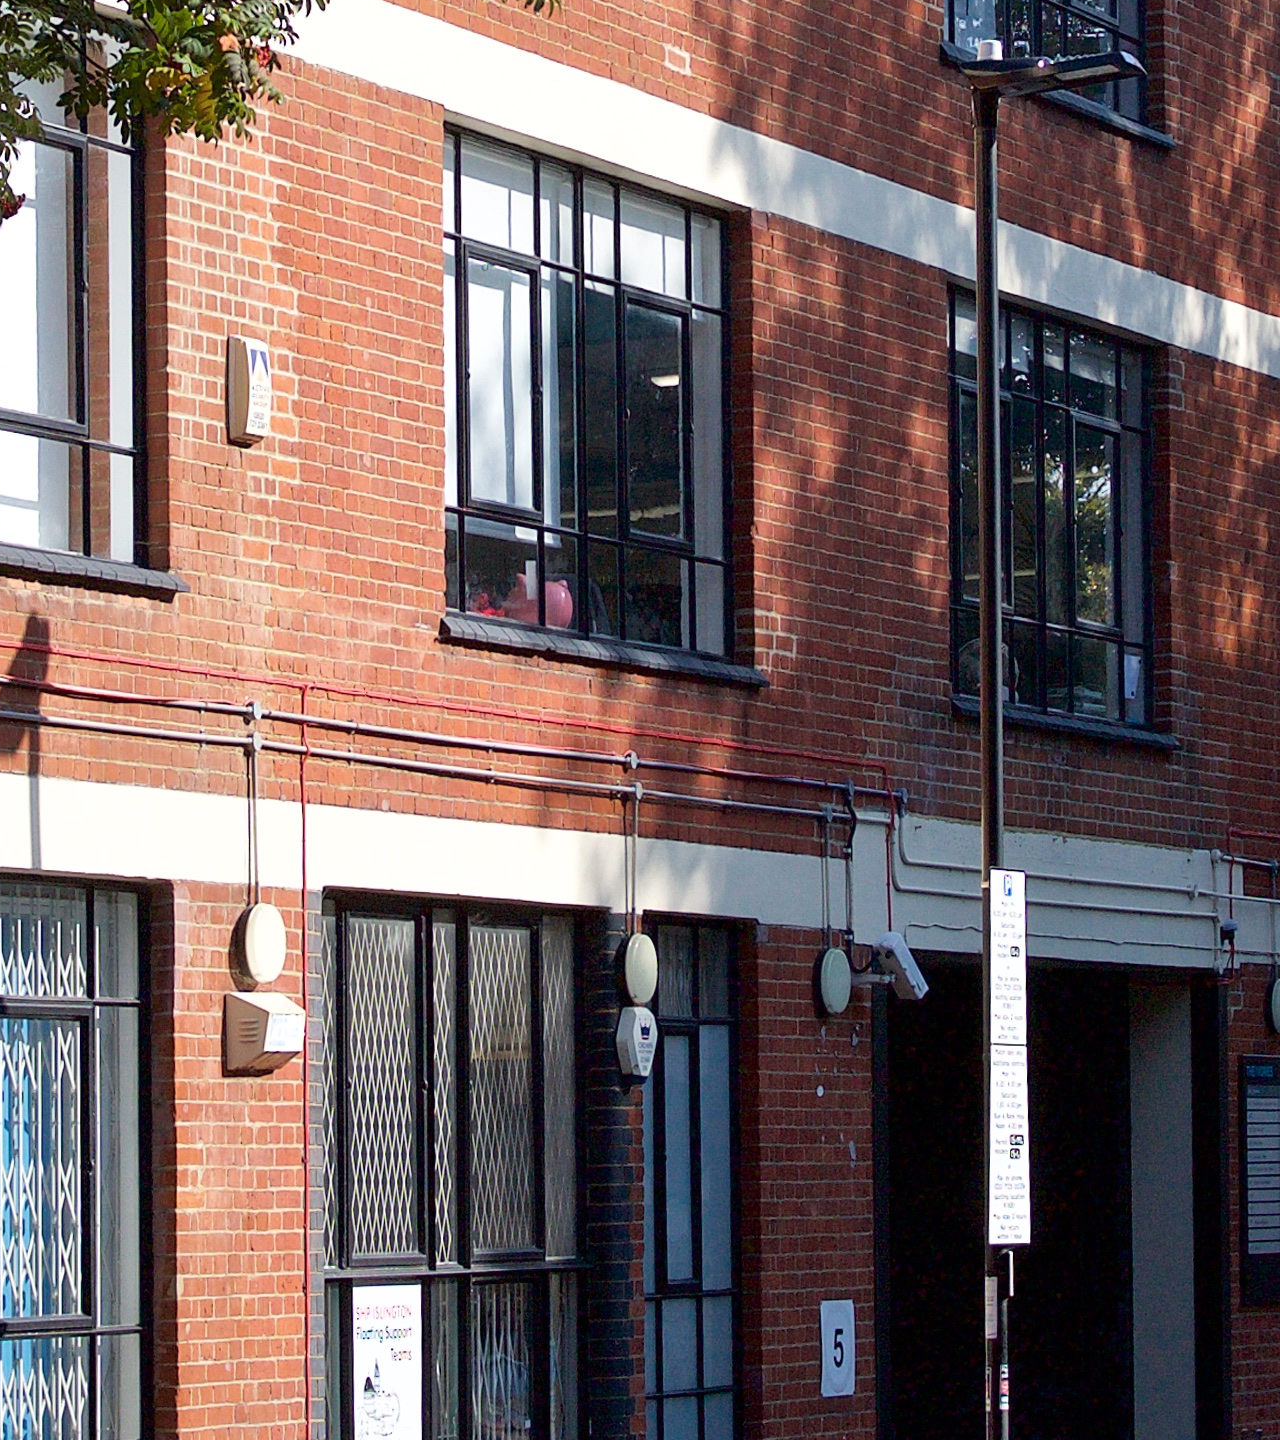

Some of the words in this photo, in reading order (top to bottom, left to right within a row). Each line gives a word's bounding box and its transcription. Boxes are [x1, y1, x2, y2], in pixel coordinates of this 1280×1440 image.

[356, 1307, 370, 1320] SHP
[373, 1305, 412, 1320] ISLINGTON
[356, 1324, 384, 1343] Floating
[385, 1325, 412, 1342] Support
[390, 1347, 412, 1361] Teams
[834, 1329, 844, 1368] 5
